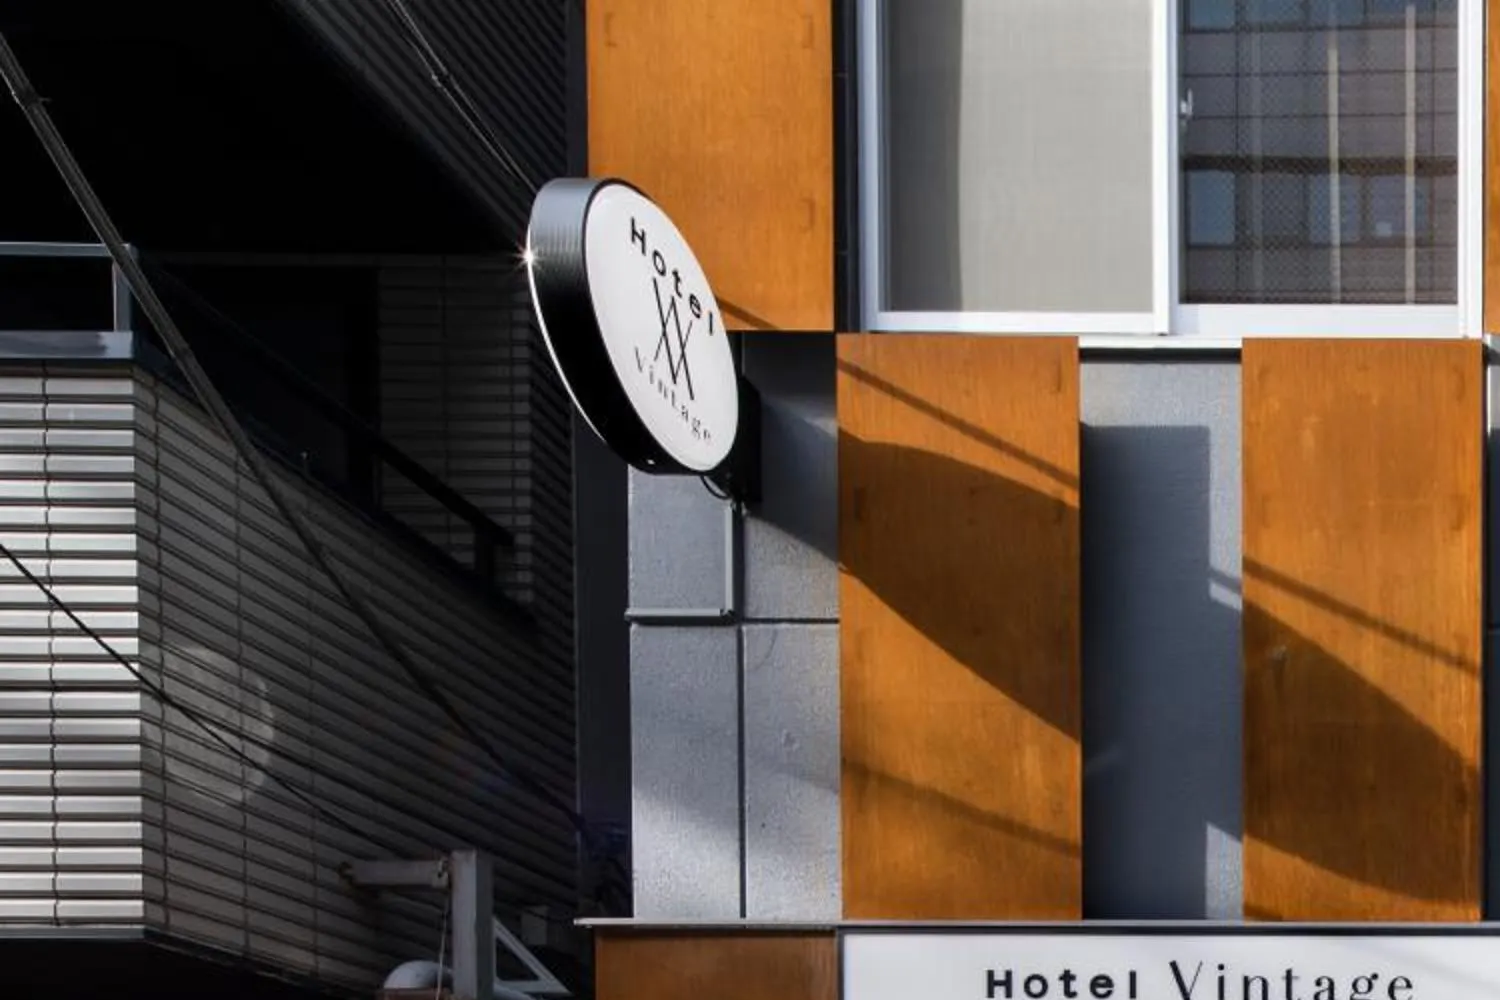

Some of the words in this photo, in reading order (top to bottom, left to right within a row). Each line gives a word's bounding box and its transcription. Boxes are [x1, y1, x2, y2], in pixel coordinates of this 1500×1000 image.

[631, 216, 713, 336] Hotel
[634, 346, 712, 441] Vintage
[987, 969, 1136, 1000] Hotel
